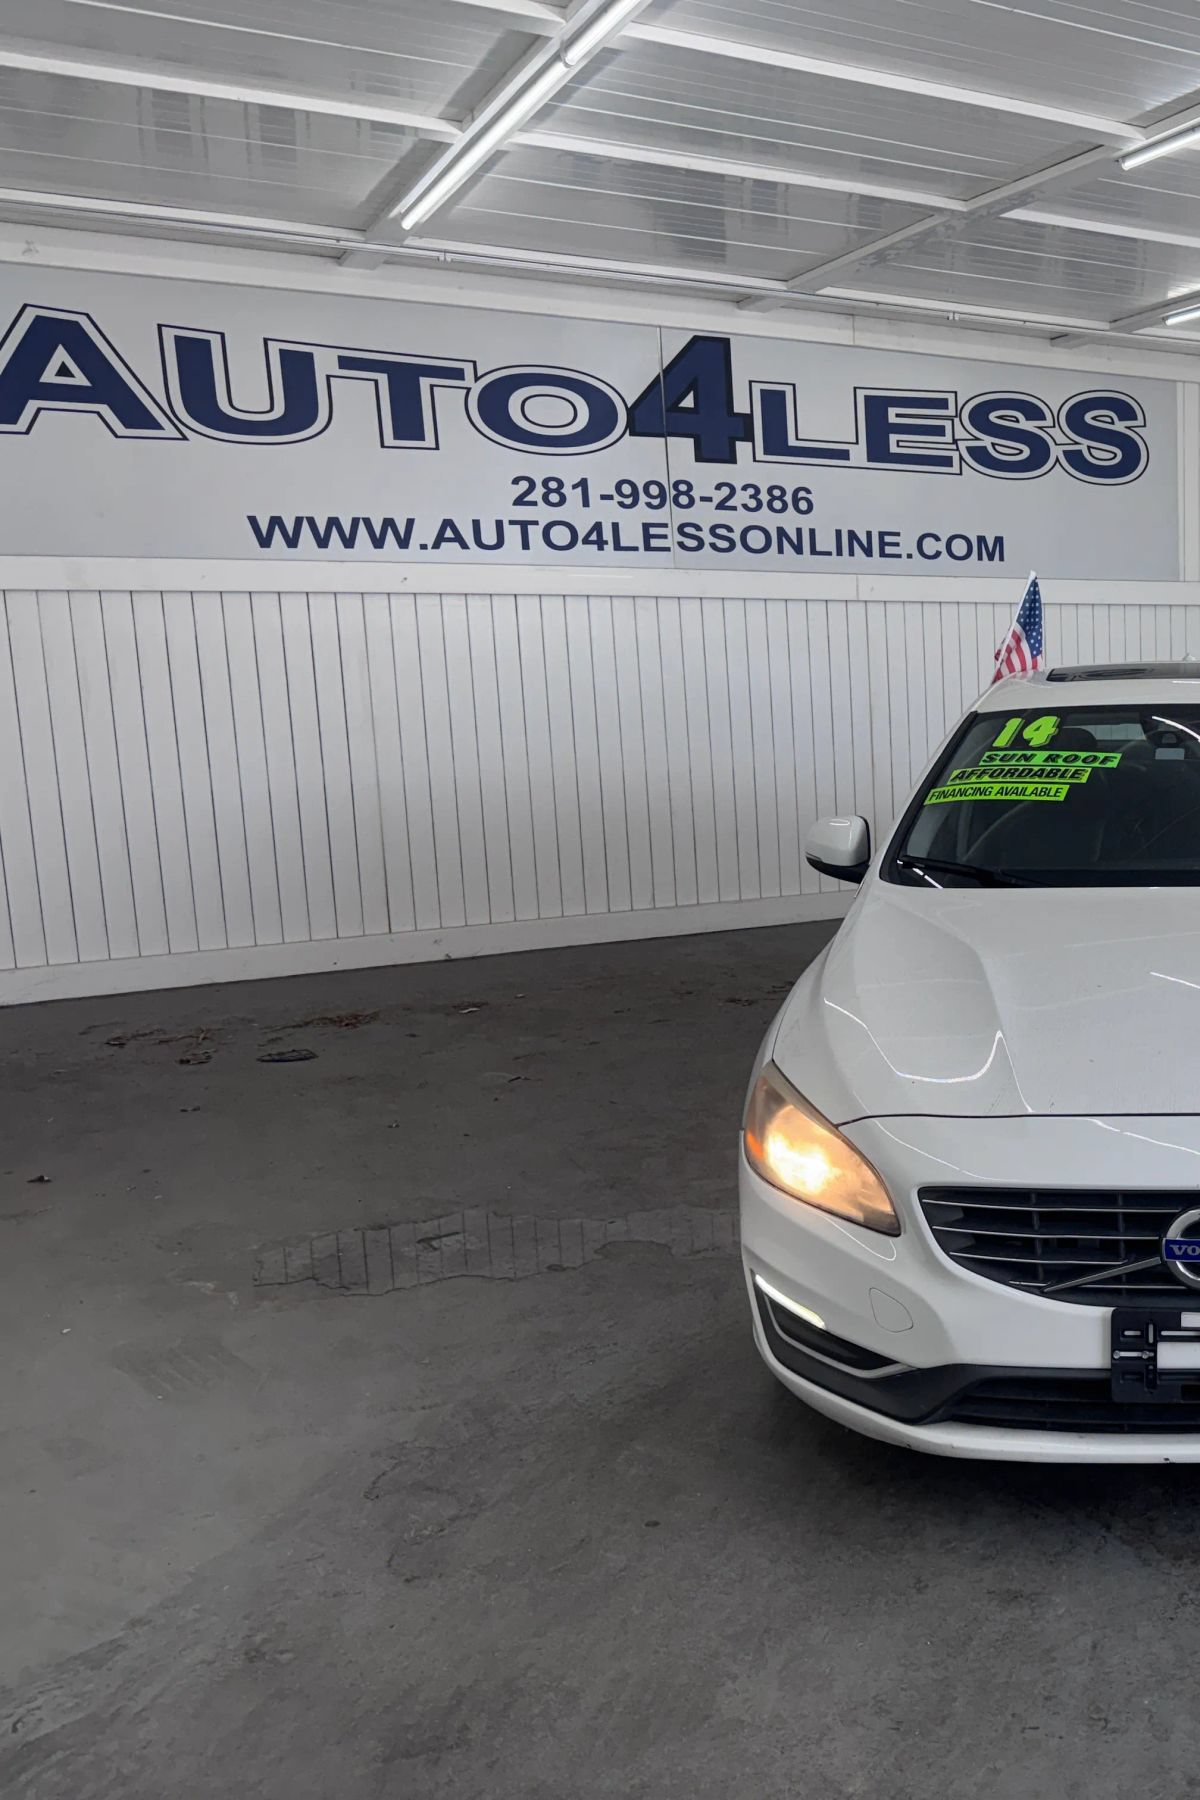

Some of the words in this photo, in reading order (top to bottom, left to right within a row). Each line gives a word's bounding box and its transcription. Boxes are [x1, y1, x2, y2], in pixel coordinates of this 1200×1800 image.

[0, 303, 1149, 486] AUTO4LESS
[511, 475, 815, 516] 281-998-2386
[247, 514, 1005, 562] WWW.AUTO4LESSONLINE.COM
[992, 716, 1060, 747] 14
[951, 767, 1084, 781] AFFORDABLE
[982, 753, 1037, 764] SUN
[1042, 753, 1118, 766] ROOF
[930, 784, 992, 801] FINANCING
[995, 785, 1063, 799] AVAILABLE
